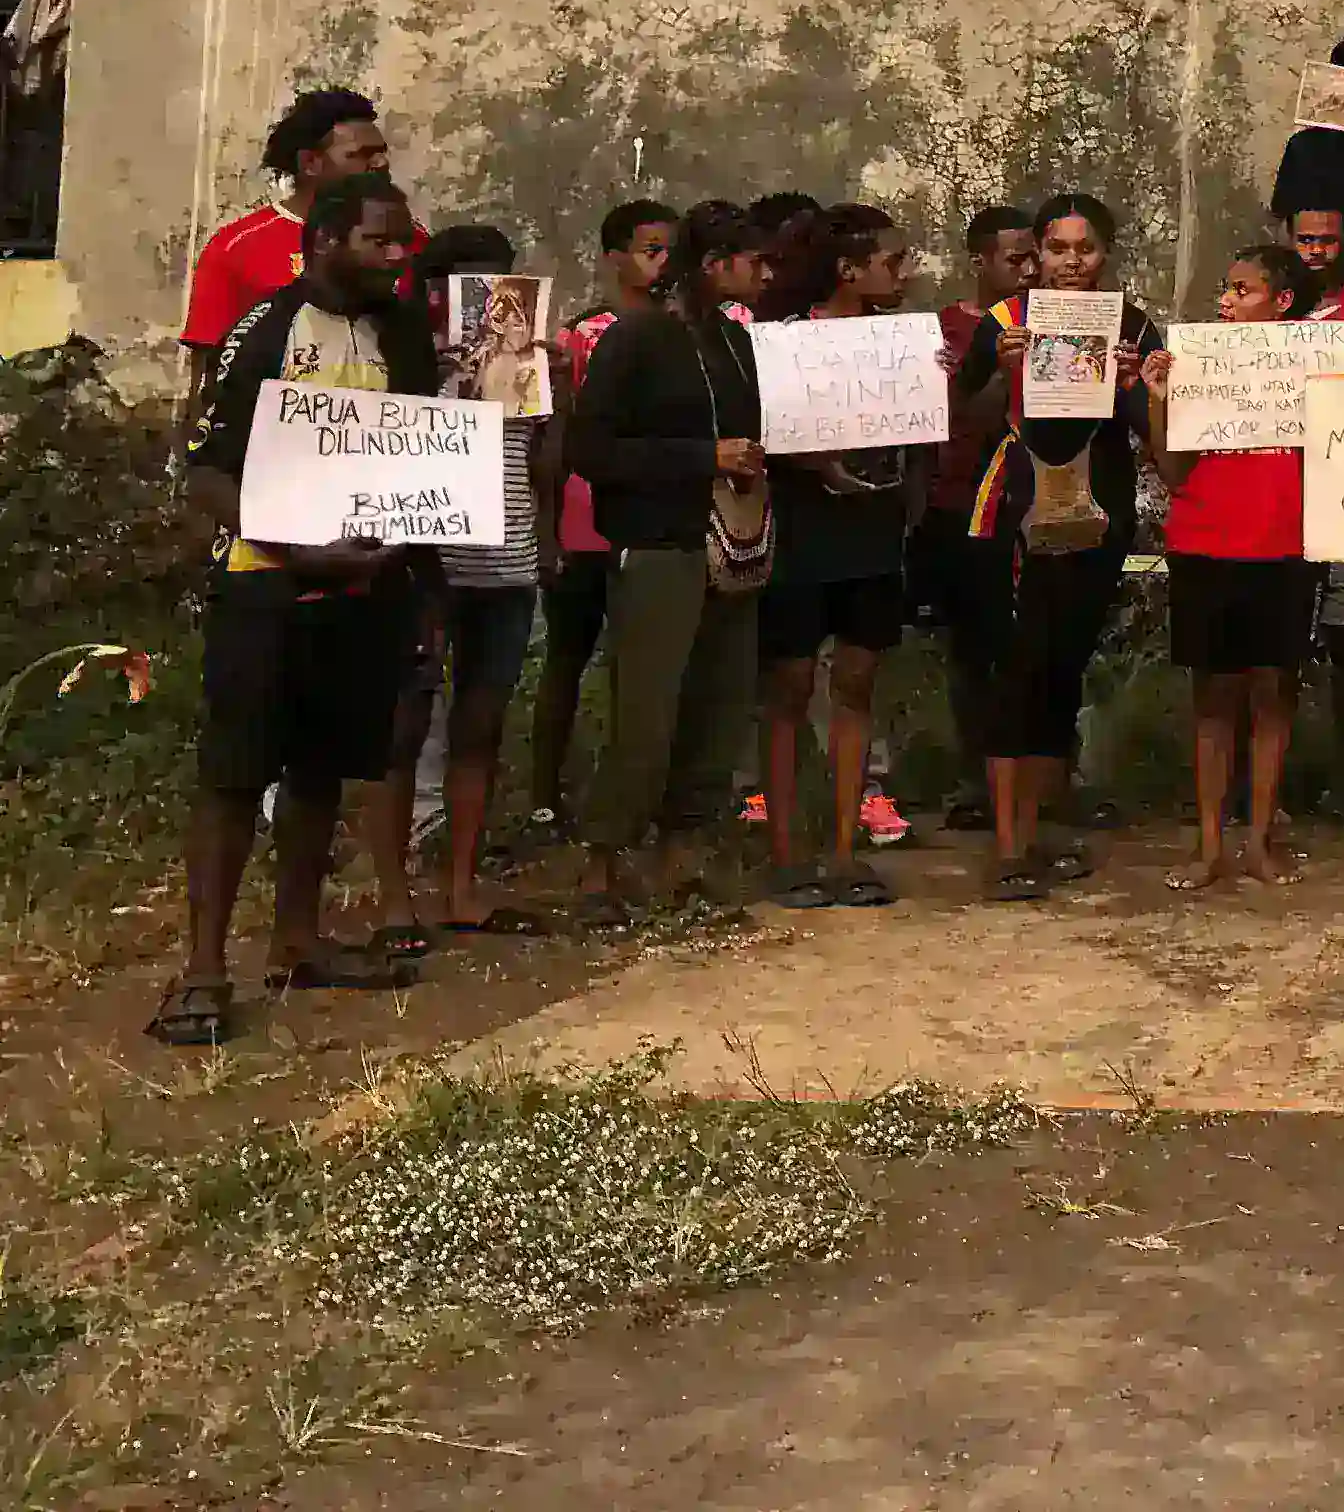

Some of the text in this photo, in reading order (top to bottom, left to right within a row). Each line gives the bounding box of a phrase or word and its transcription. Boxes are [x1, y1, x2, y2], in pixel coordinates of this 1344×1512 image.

[279, 387, 478, 432] PAPUA BUTUH
[313, 425, 473, 456] DILINDUNGI
[347, 487, 452, 517] BUKAN
[340, 510, 473, 540] INTIMIDASI
